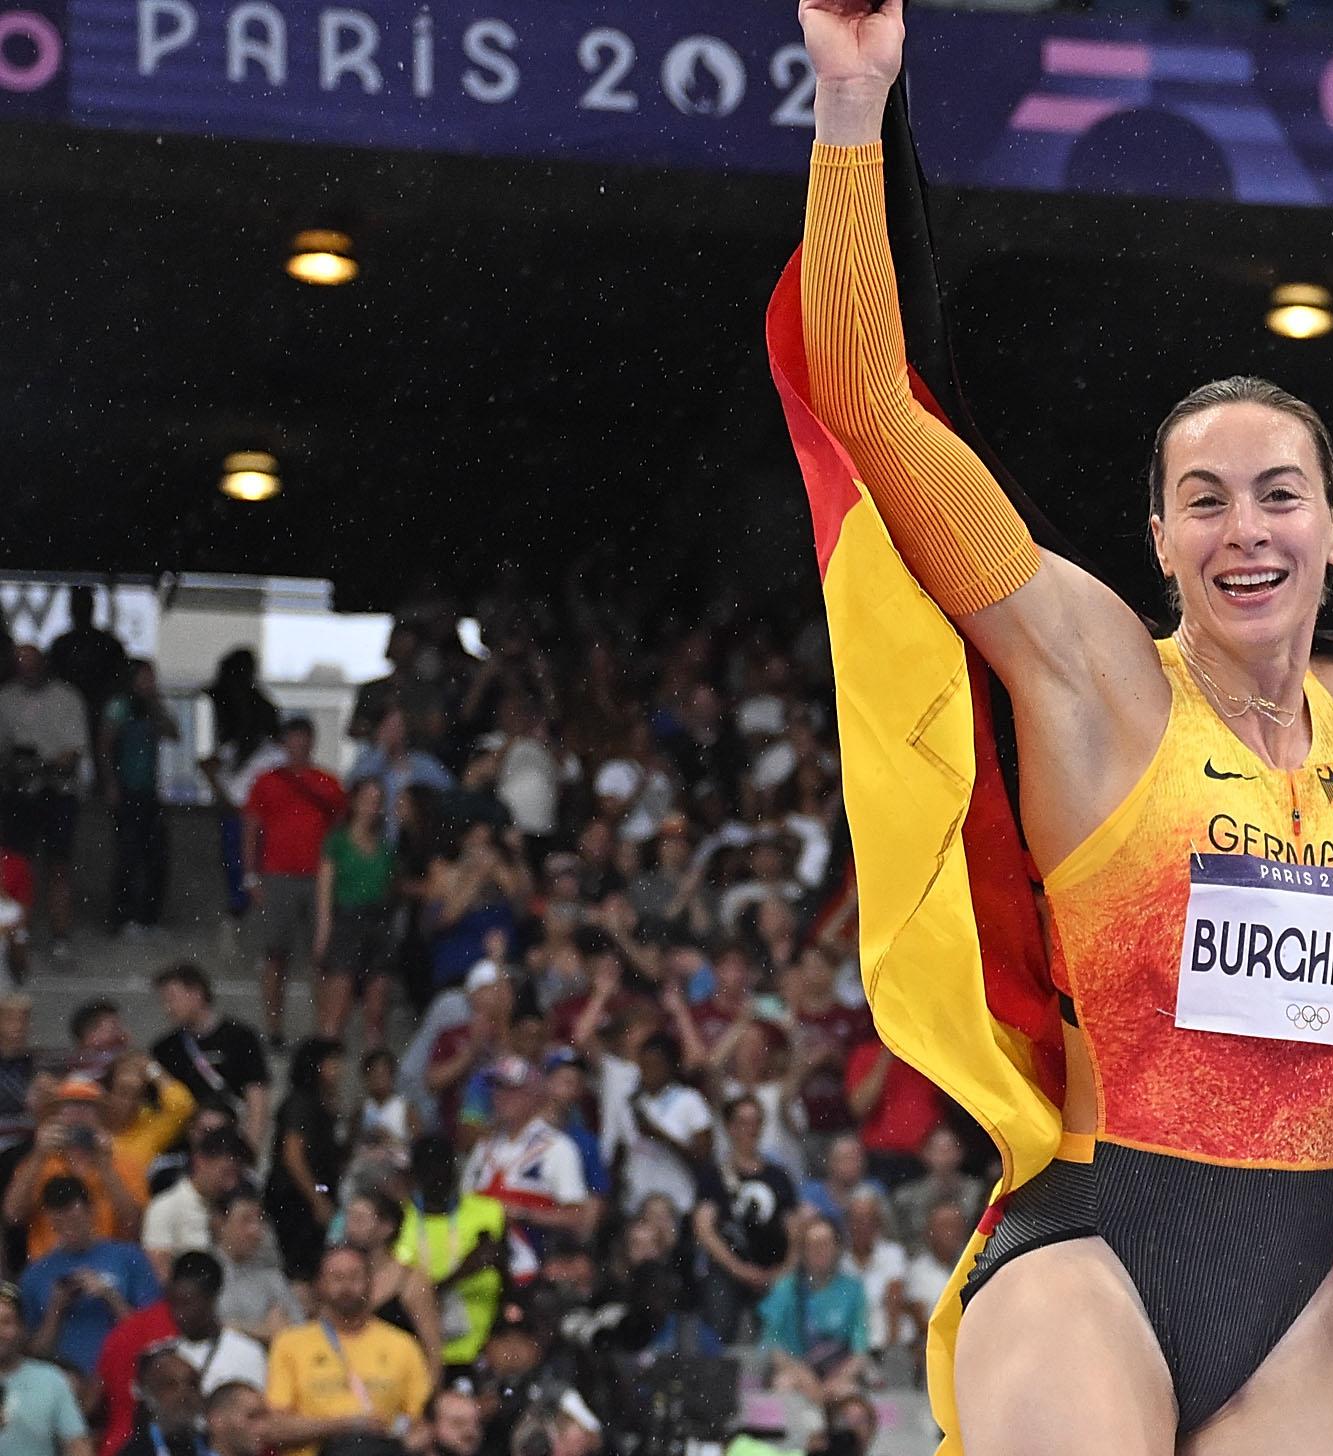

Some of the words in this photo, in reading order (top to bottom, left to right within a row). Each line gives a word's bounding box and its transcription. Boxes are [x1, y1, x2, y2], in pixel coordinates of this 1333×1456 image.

[137, 0, 520, 104] PARIS
[577, 29, 816, 126] 202
[1260, 864, 1313, 885] PARIS
